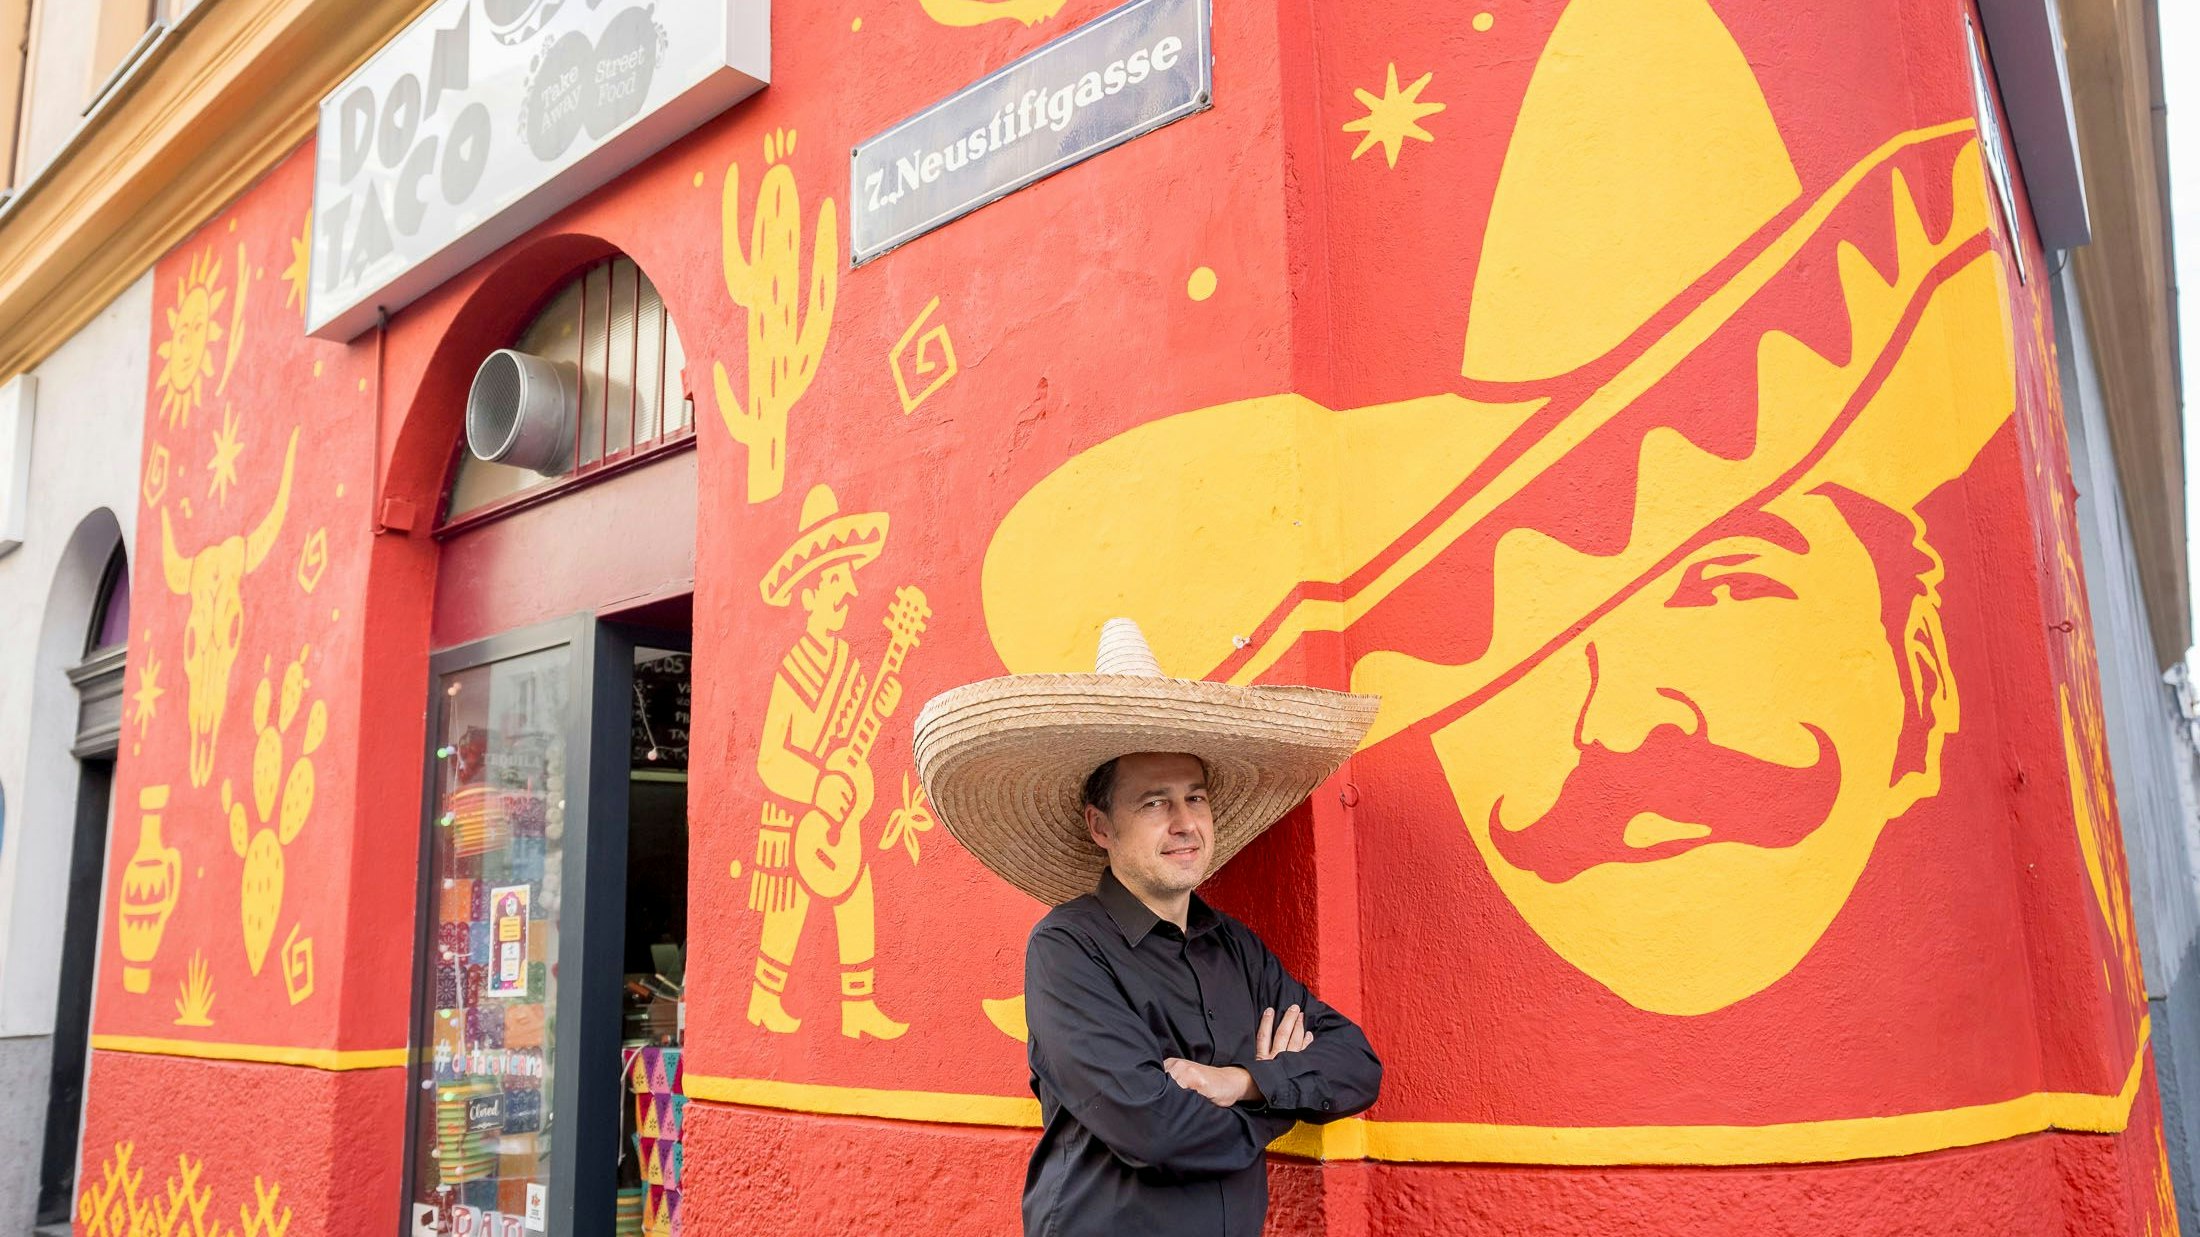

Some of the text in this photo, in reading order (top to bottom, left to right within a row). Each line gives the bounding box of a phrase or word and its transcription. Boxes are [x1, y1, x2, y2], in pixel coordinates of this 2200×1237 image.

[595, 44, 645, 83] Street
[340, 0, 470, 187] DON
[541, 66, 579, 109] Take
[541, 85, 583, 134] Away
[598, 72, 636, 107] Food
[896, 35, 1183, 197] Neustiftgasse
[323, 102, 492, 293] TACO
[469, 1099, 501, 1121] Closed
